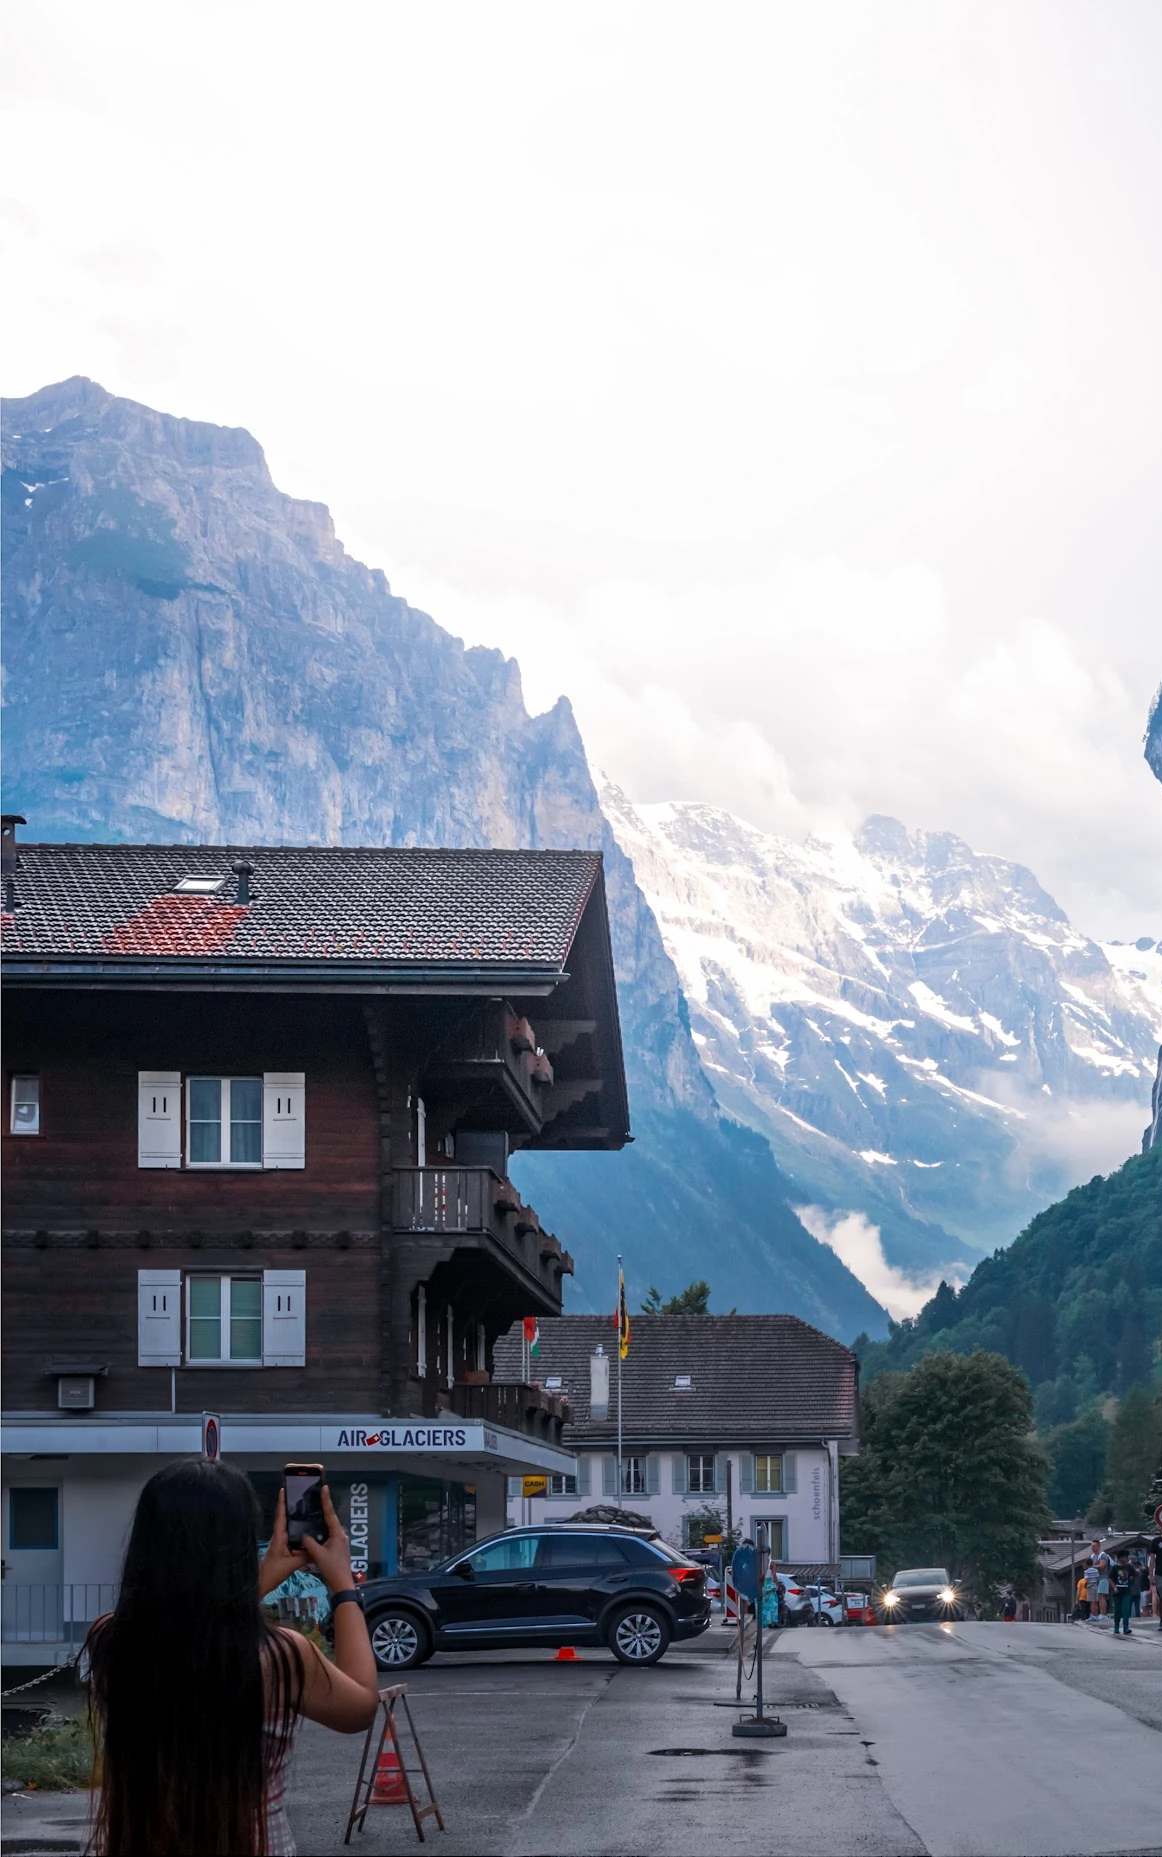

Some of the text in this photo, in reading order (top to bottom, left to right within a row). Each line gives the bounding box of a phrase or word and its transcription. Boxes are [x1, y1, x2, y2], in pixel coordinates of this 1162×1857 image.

[337, 1430, 367, 1447] AIR
[380, 1430, 466, 1447] GLACIERS
[812, 1467, 821, 1520] schoenfels
[350, 1482, 369, 1573] GLACIERS
